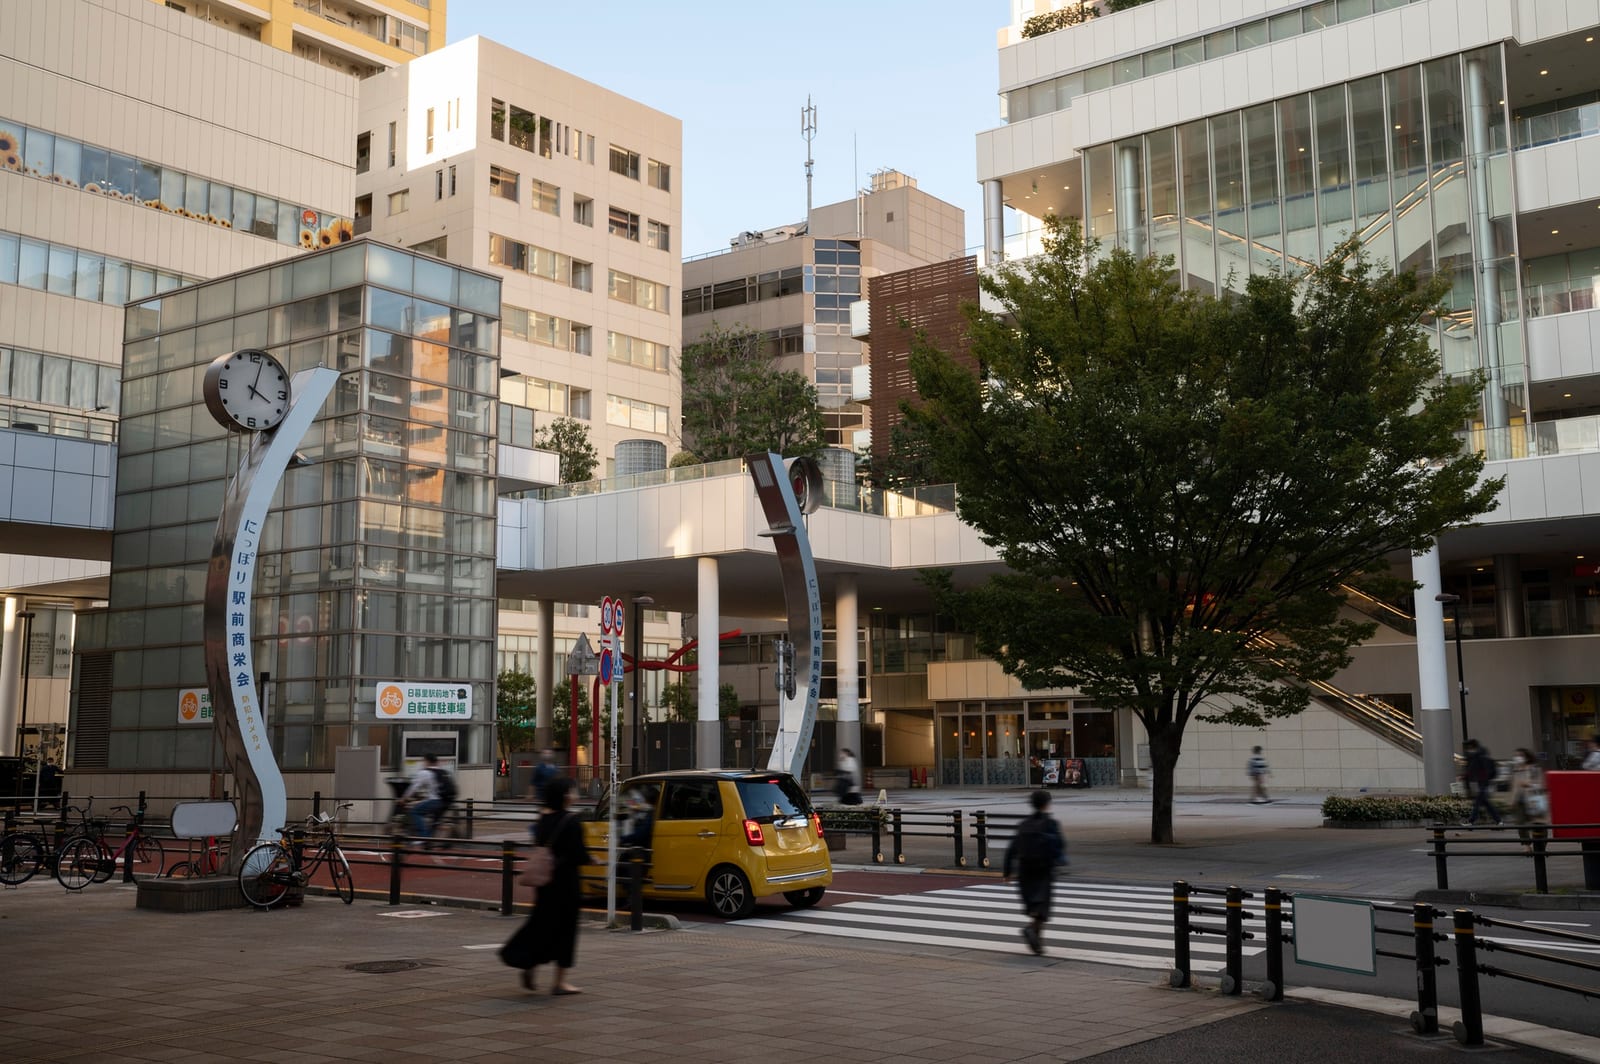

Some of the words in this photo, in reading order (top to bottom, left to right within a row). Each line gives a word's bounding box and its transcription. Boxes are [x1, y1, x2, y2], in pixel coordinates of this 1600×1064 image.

[249, 352, 261, 364] 12
[219, 379, 228, 389] 9
[278, 390, 287, 401] 3
[247, 417, 256, 427] 6
[231, 519, 258, 687] にっぽり駅前商栄会
[407, 688, 456, 699] 日暮里駅前地下
[407, 701, 466, 714] 自転車駐車場
